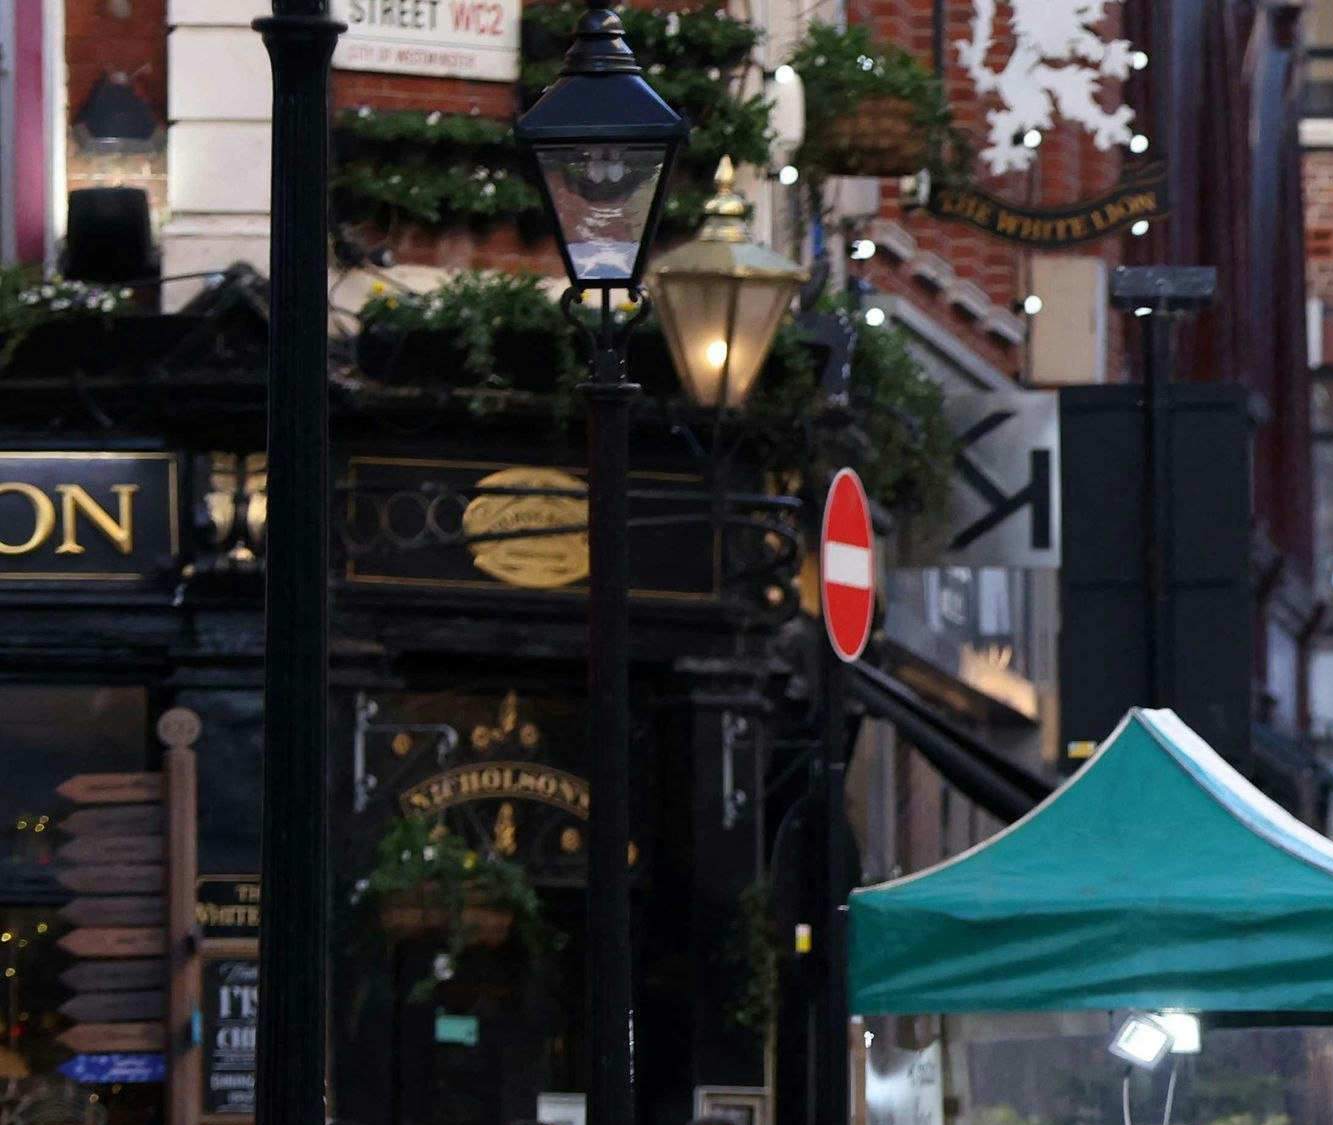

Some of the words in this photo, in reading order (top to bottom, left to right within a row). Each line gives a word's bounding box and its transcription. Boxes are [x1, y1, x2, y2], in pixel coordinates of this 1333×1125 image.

[350, 0, 438, 30] STREET
[452, 0, 503, 35] WC2
[996, 209, 1088, 241] WHITE
[1090, 191, 1158, 231] LION
